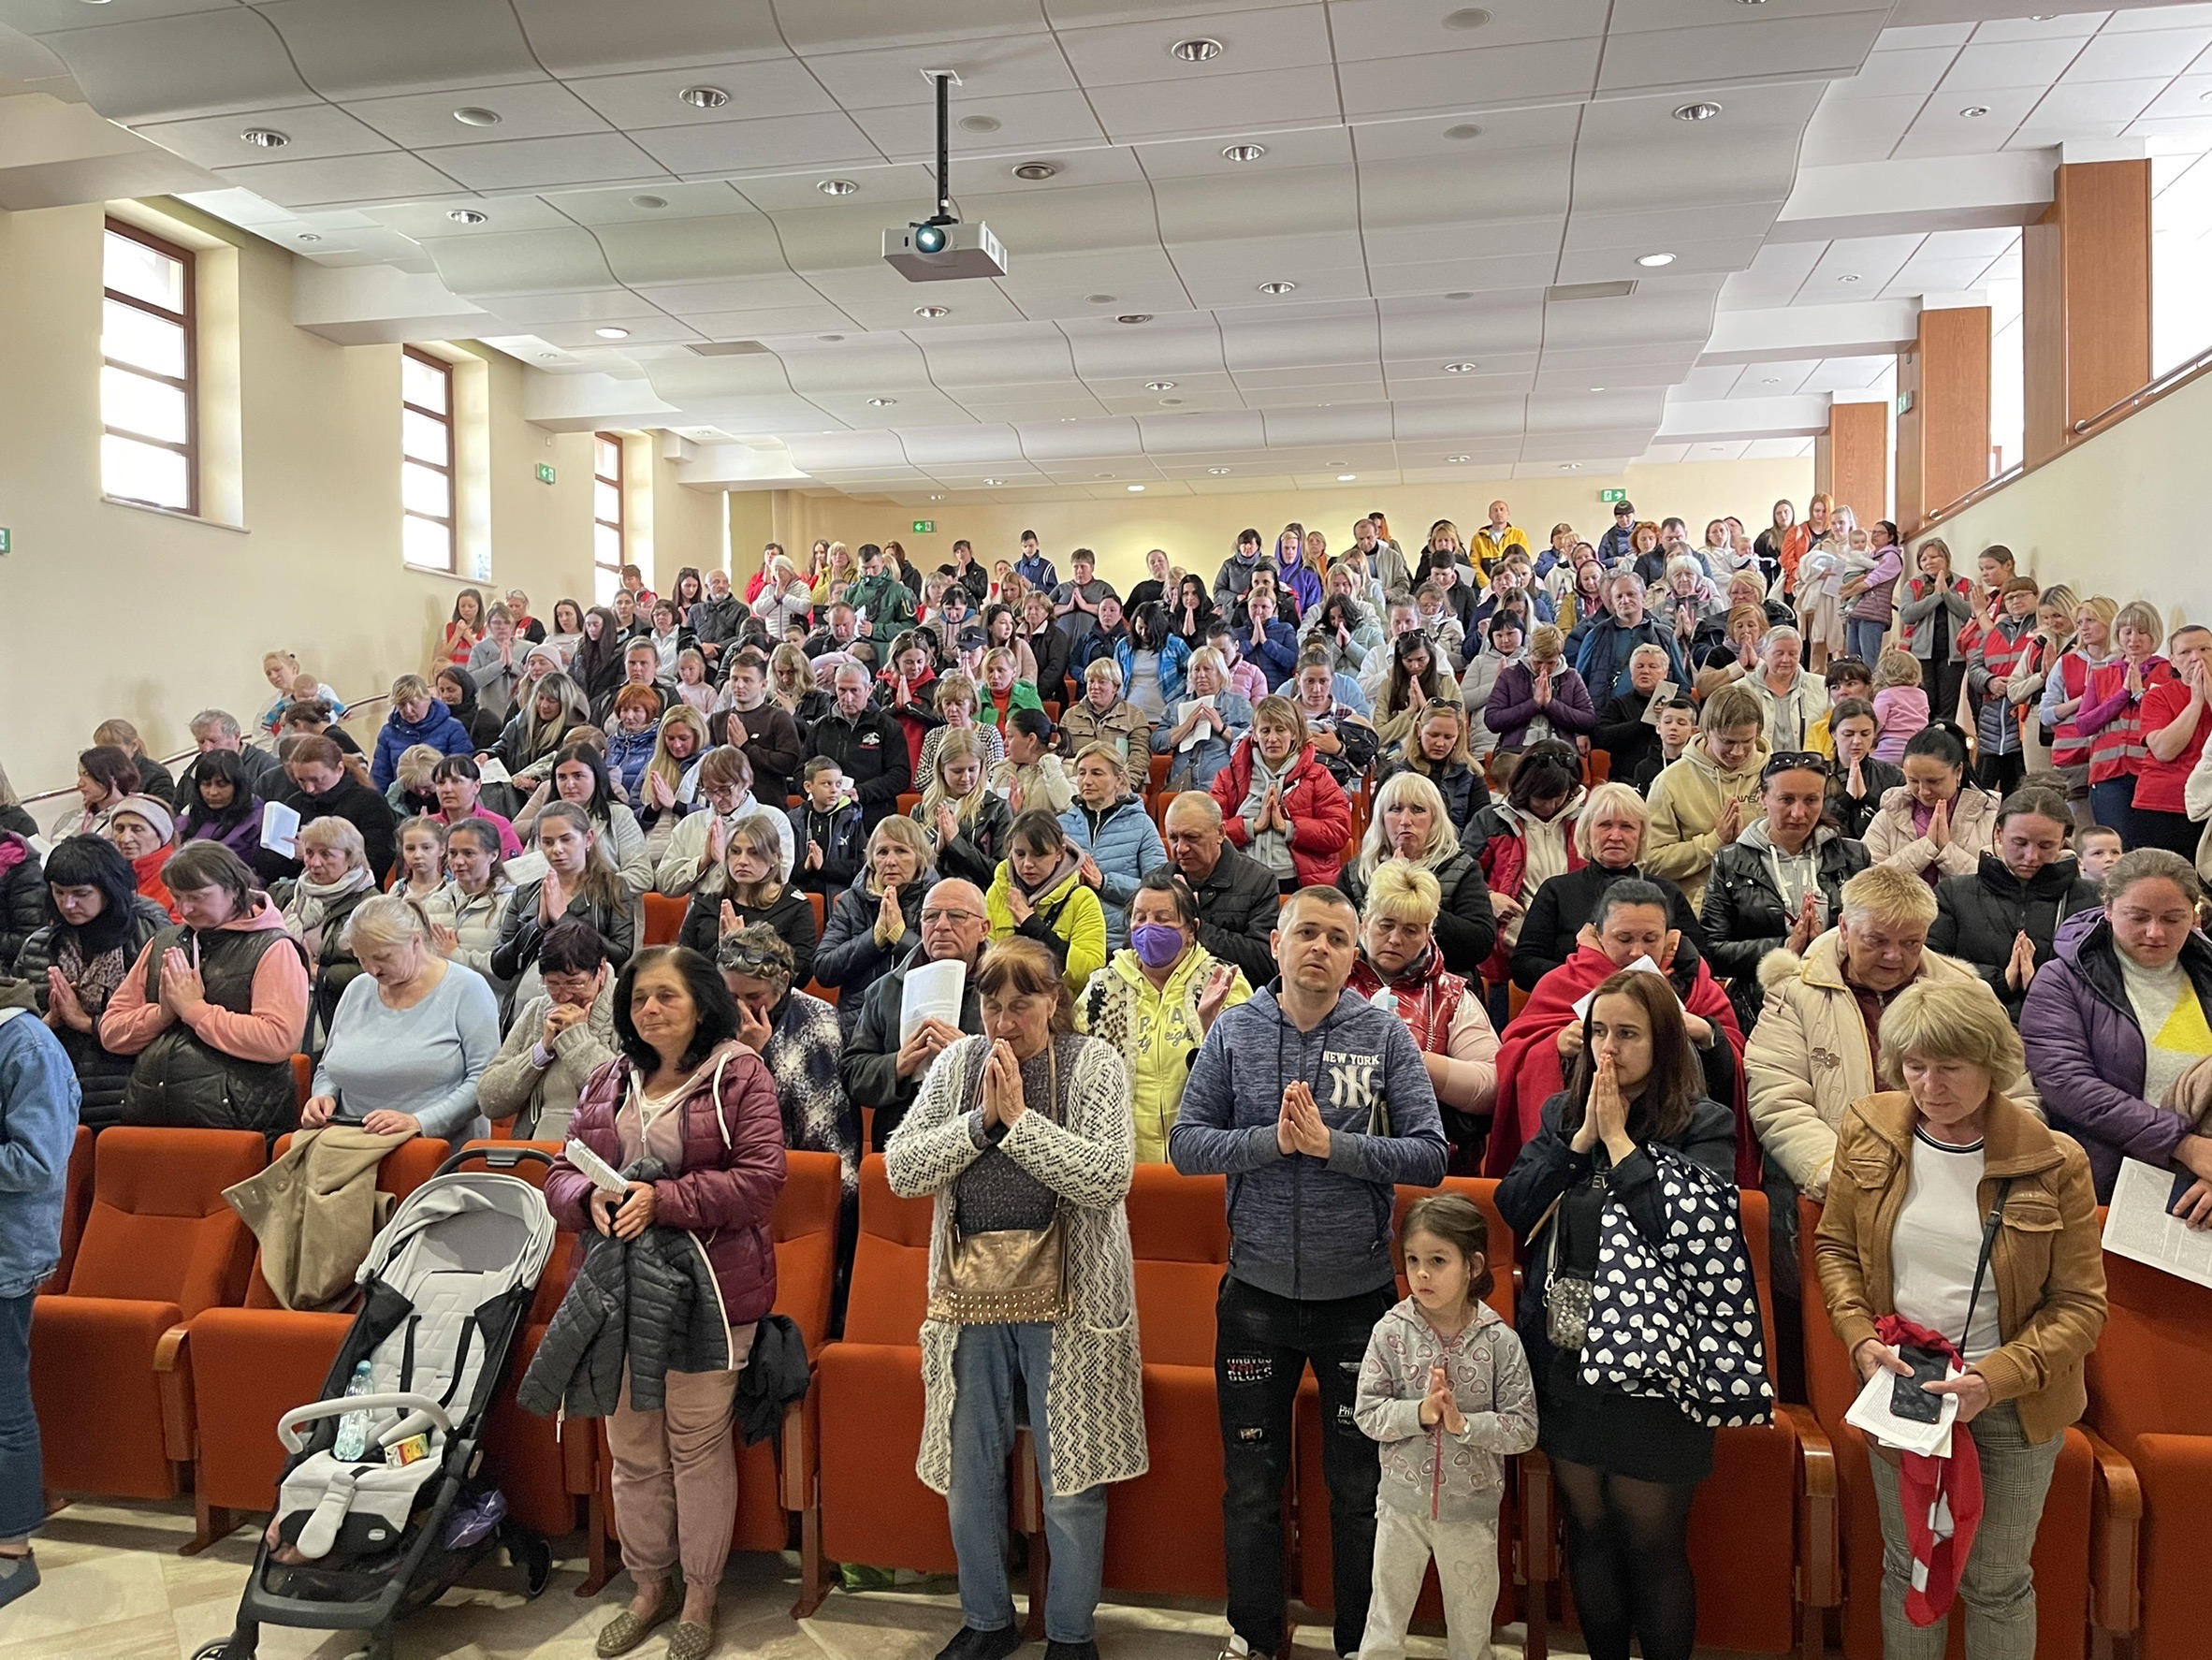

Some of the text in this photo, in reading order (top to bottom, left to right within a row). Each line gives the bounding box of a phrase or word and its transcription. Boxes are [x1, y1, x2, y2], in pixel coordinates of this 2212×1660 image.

[1322, 1050, 1379, 1066] NEW YORK
[1329, 1064, 1375, 1109] NY
